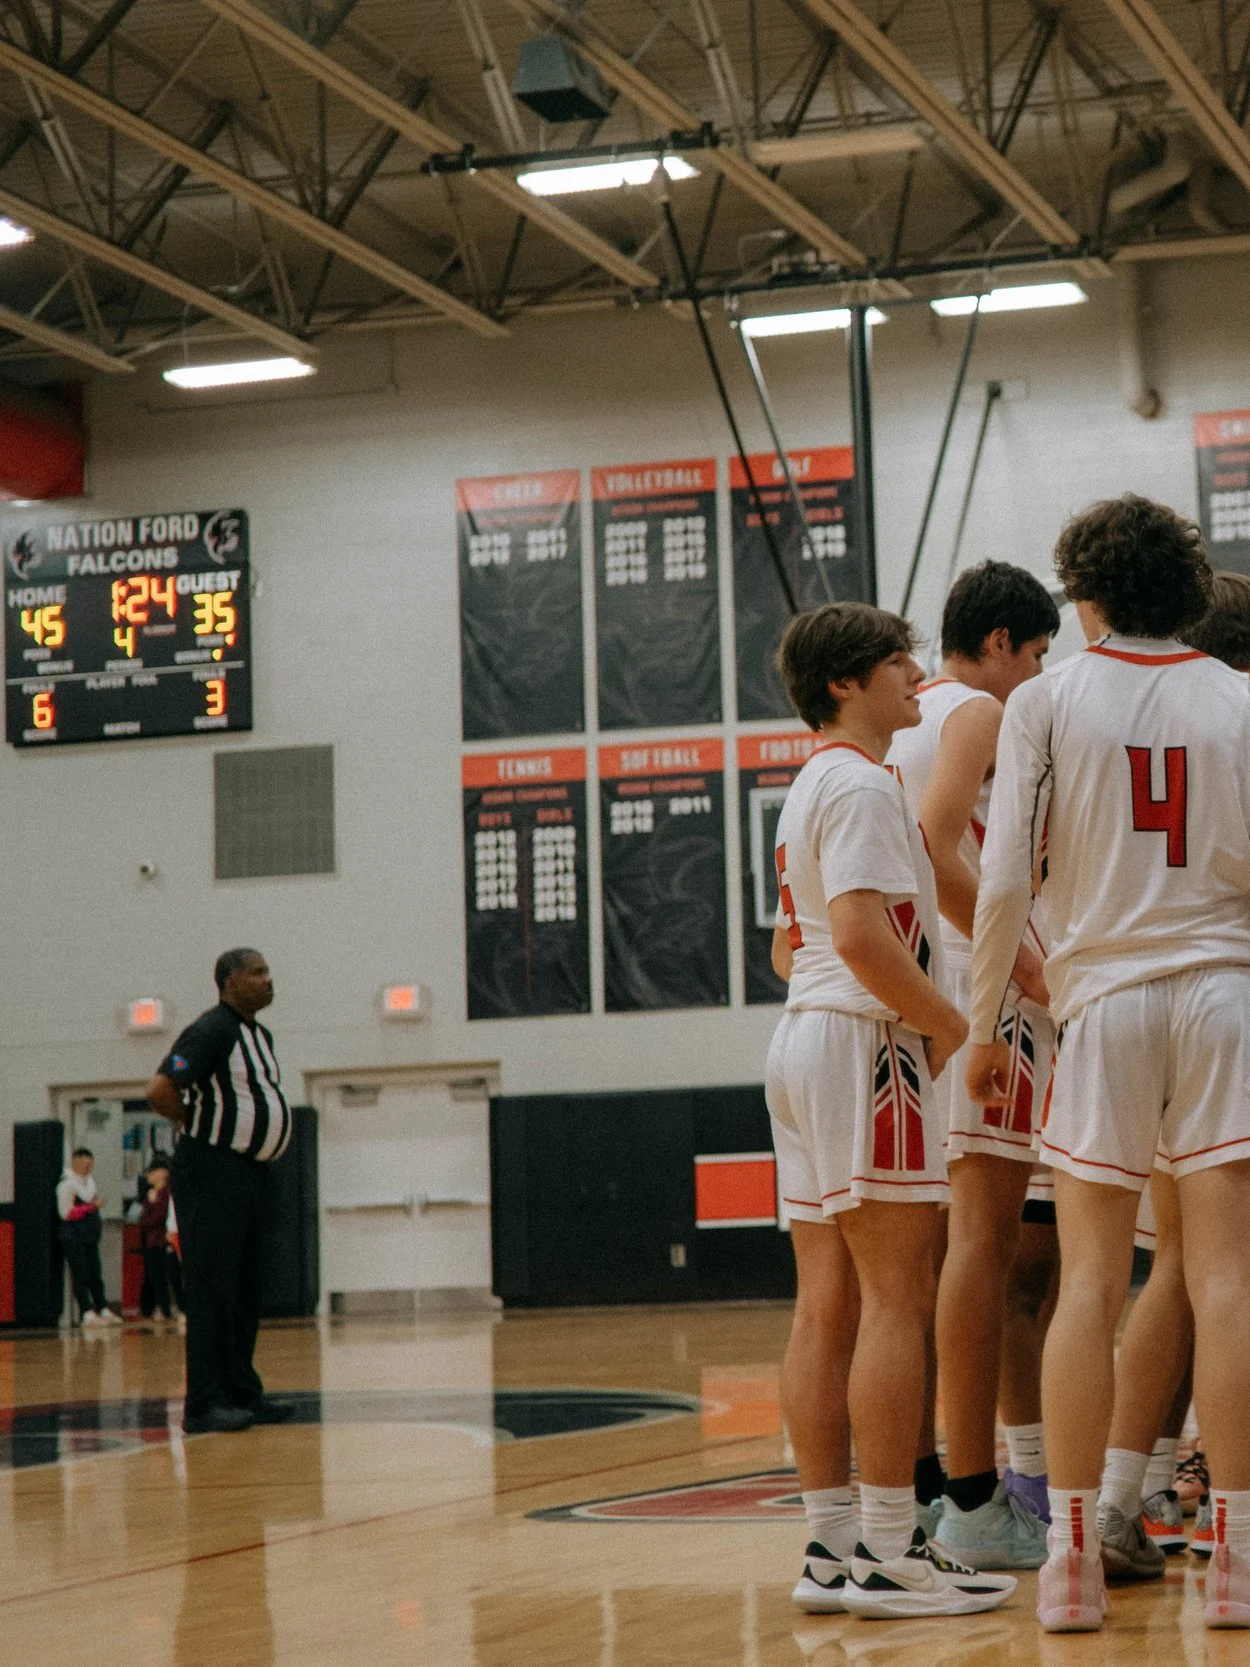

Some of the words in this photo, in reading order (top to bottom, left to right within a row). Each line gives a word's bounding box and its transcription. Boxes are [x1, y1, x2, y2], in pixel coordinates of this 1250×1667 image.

[606, 468, 702, 492] VOLLEYBALL
[47, 519, 133, 550] NATION
[139, 513, 200, 544] FORD
[67, 546, 179, 576] FALCONS
[8, 585, 67, 607] HOME
[111, 575, 177, 624] 1:24
[176, 570, 241, 595] GUEST
[20, 605, 66, 647] 45
[193, 591, 237, 635] 35
[113, 626, 135, 658] 4
[32, 691, 54, 730] 6
[205, 679, 226, 716] 3
[498, 757, 552, 778] TENNIS
[620, 747, 700, 771] SOFTBALL
[1124, 745, 1187, 867] 4
